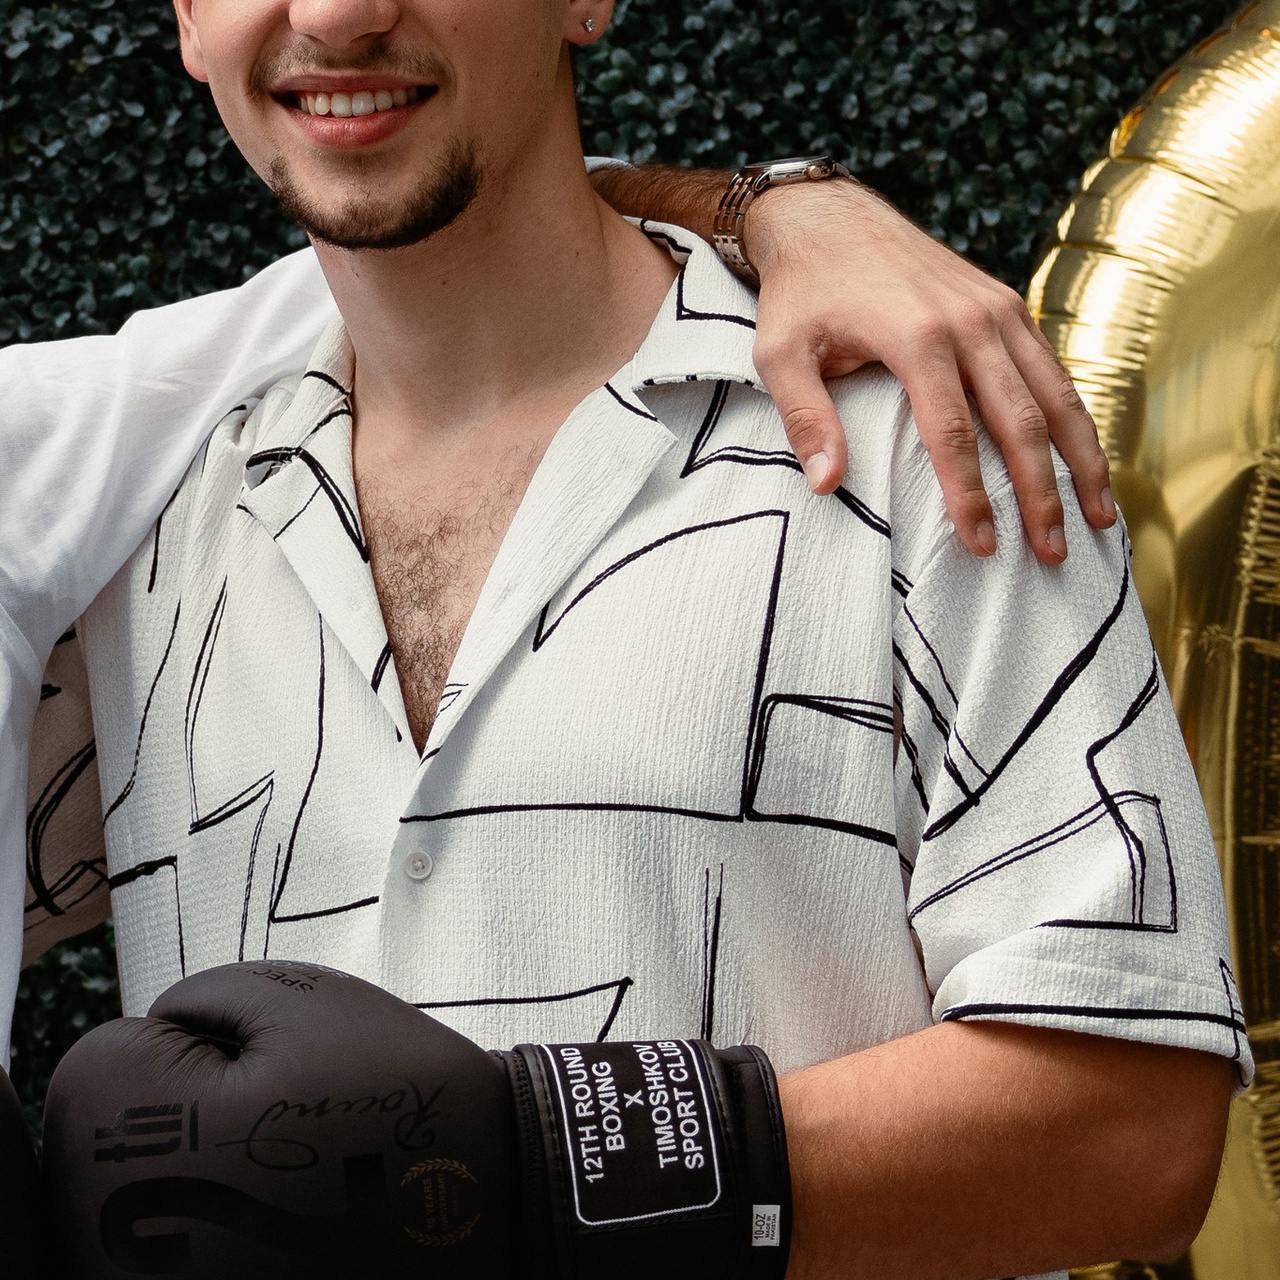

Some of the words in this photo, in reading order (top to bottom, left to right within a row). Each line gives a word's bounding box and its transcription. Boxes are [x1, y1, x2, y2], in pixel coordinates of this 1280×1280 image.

[560, 1047, 592, 1119] ROUND
[657, 1040, 690, 1080] CLUB
[592, 1061, 625, 1151] BOXING
[624, 1090, 644, 1108] X
[632, 1044, 678, 1169] TIMOSHKOV
[674, 1089, 705, 1169] SPORT
[578, 1125, 604, 1183] 12TH
